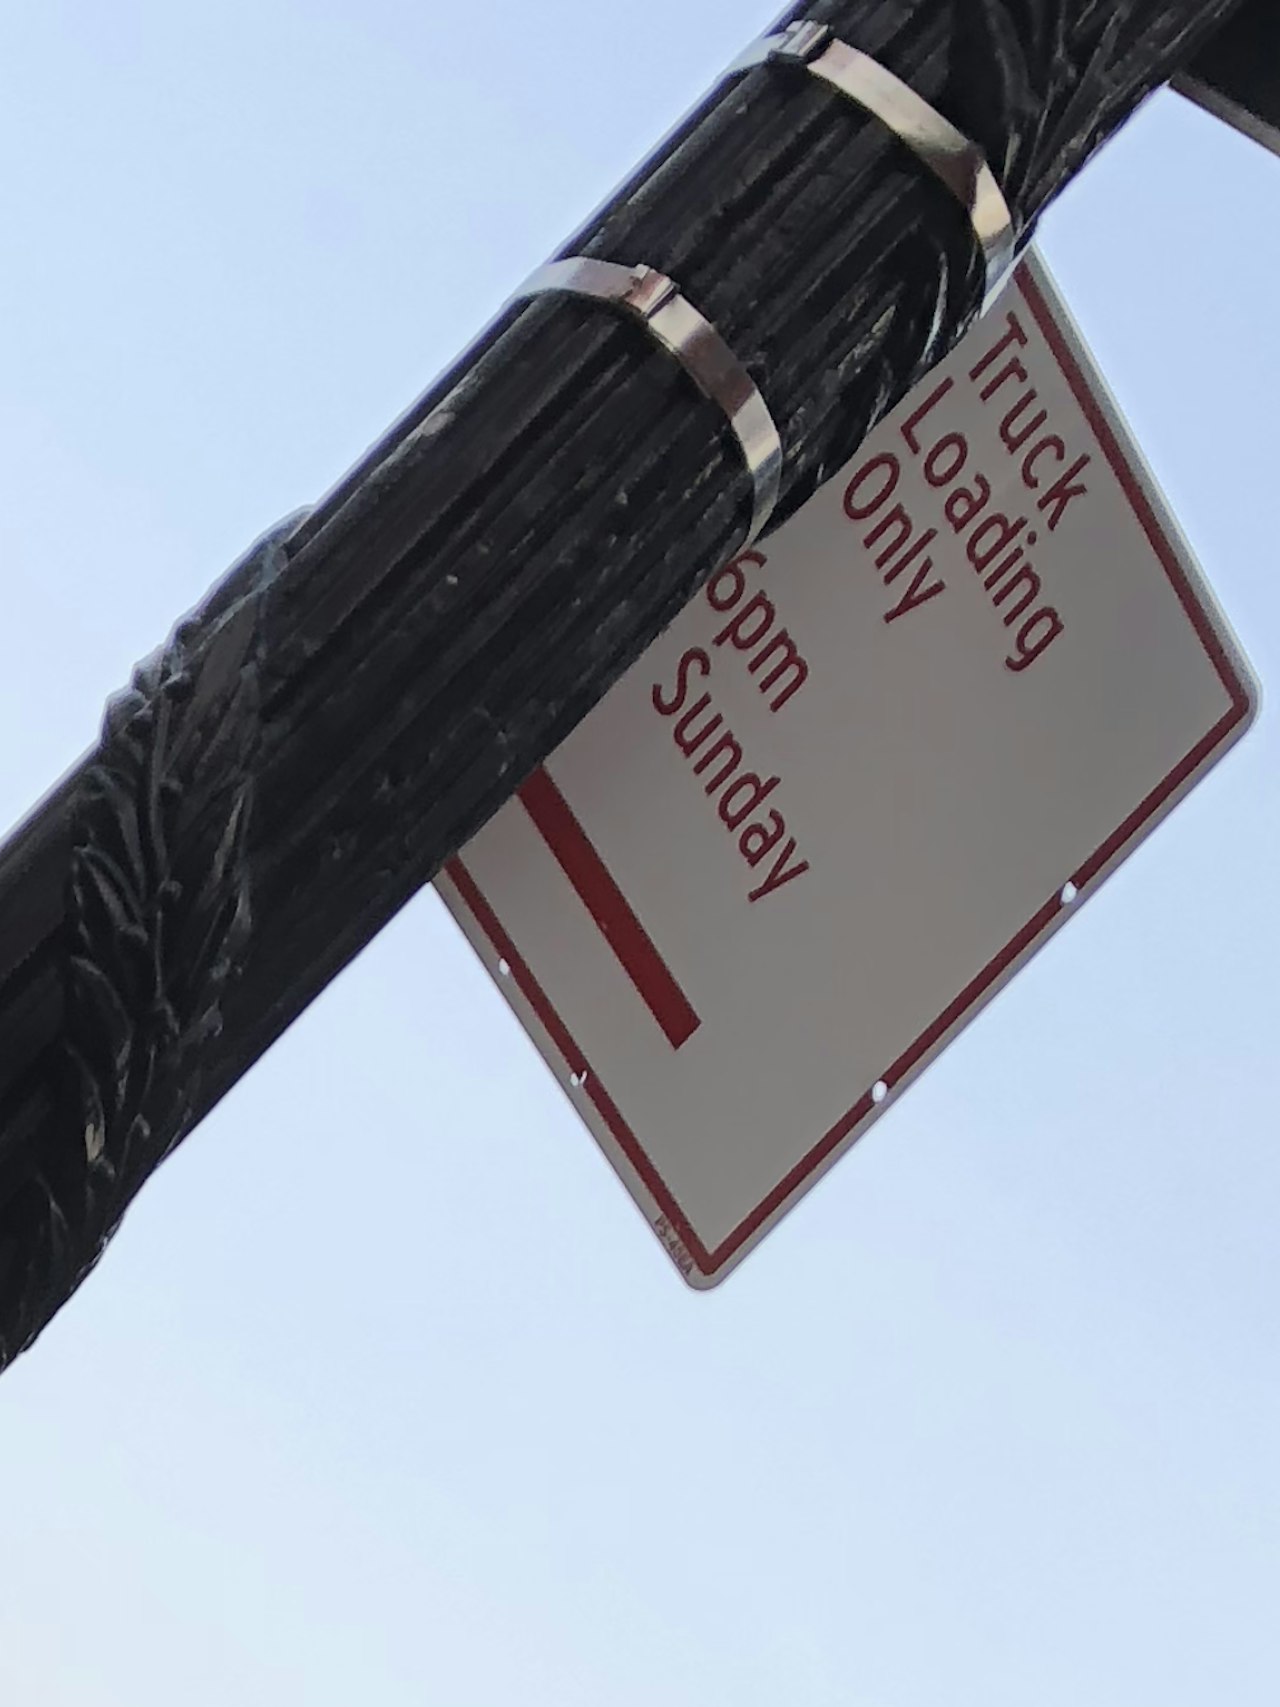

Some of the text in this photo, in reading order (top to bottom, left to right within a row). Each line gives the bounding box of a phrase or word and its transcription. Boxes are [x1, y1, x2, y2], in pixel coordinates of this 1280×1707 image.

[841, 455, 944, 624] Only
[899, 381, 1065, 672] Loading
[969, 312, 1092, 532] Truck
[652, 648, 809, 904] Sunday
